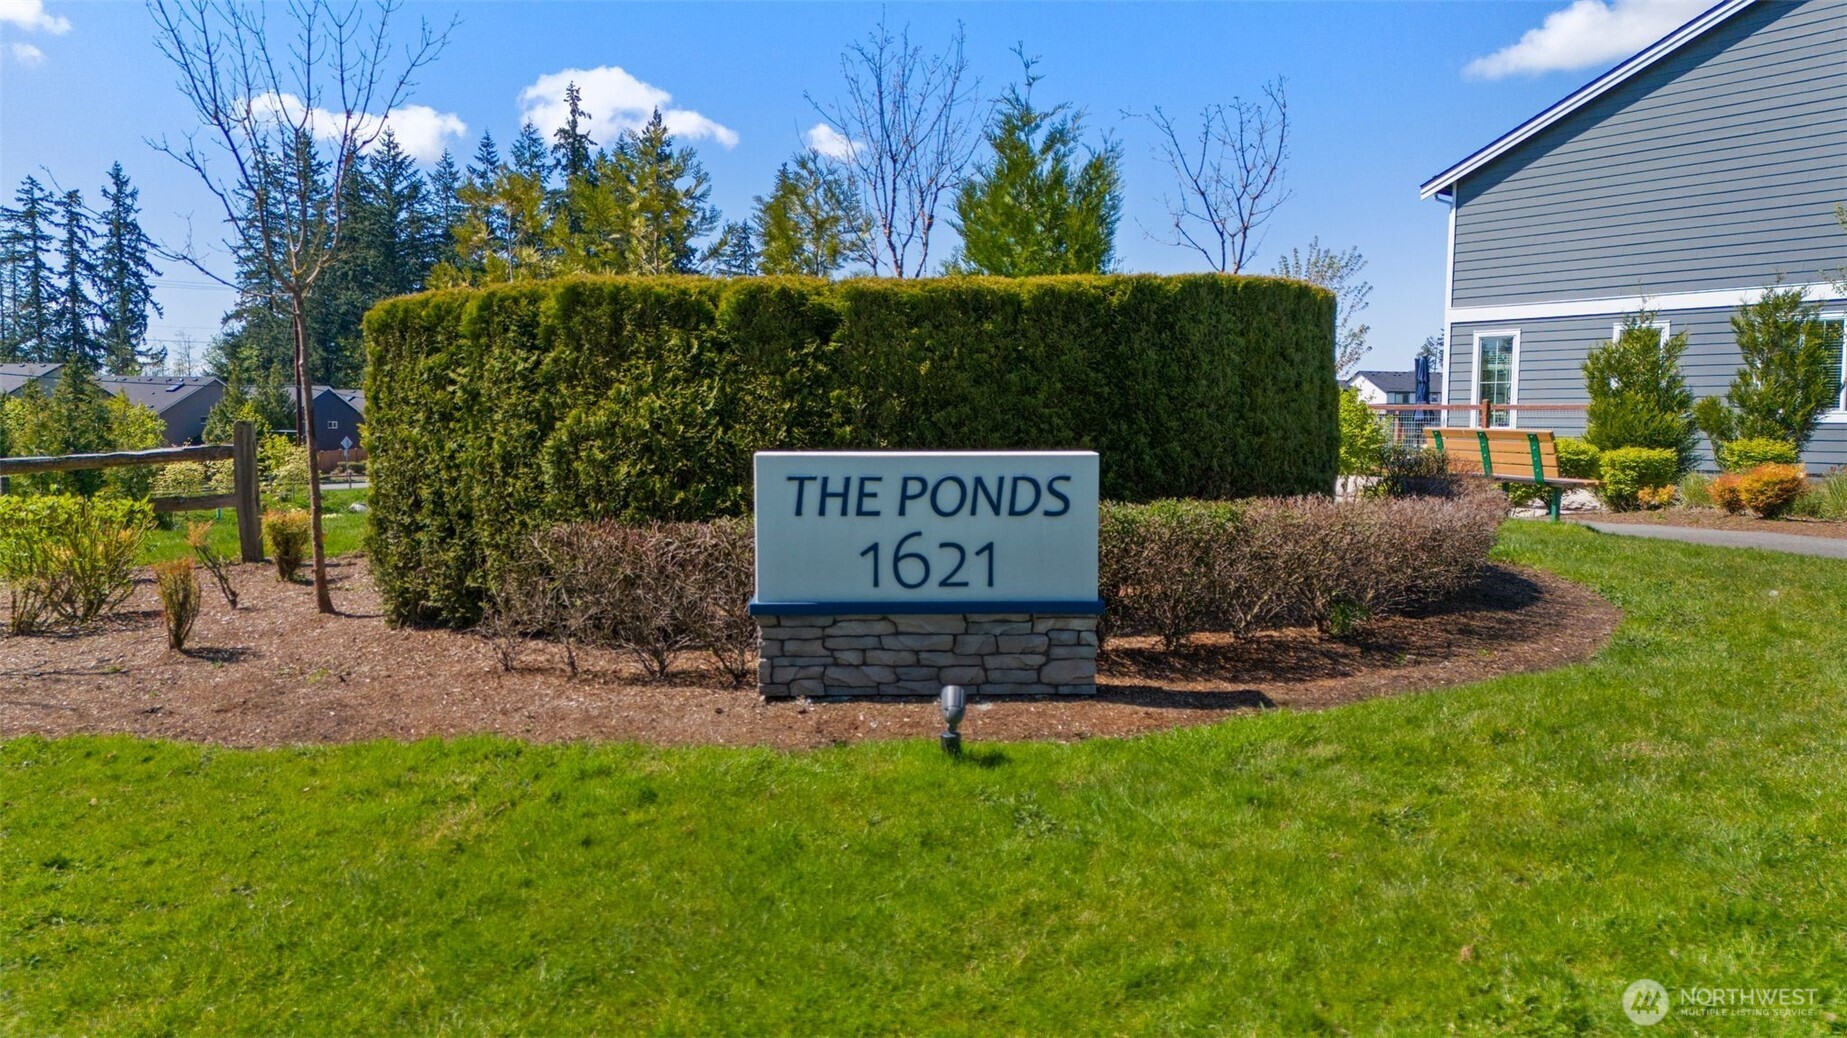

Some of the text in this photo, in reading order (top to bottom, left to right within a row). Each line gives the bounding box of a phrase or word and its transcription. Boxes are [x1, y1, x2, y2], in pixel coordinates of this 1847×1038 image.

[787, 475, 1071, 518] THE PONDS
[860, 531, 995, 590] 1621
